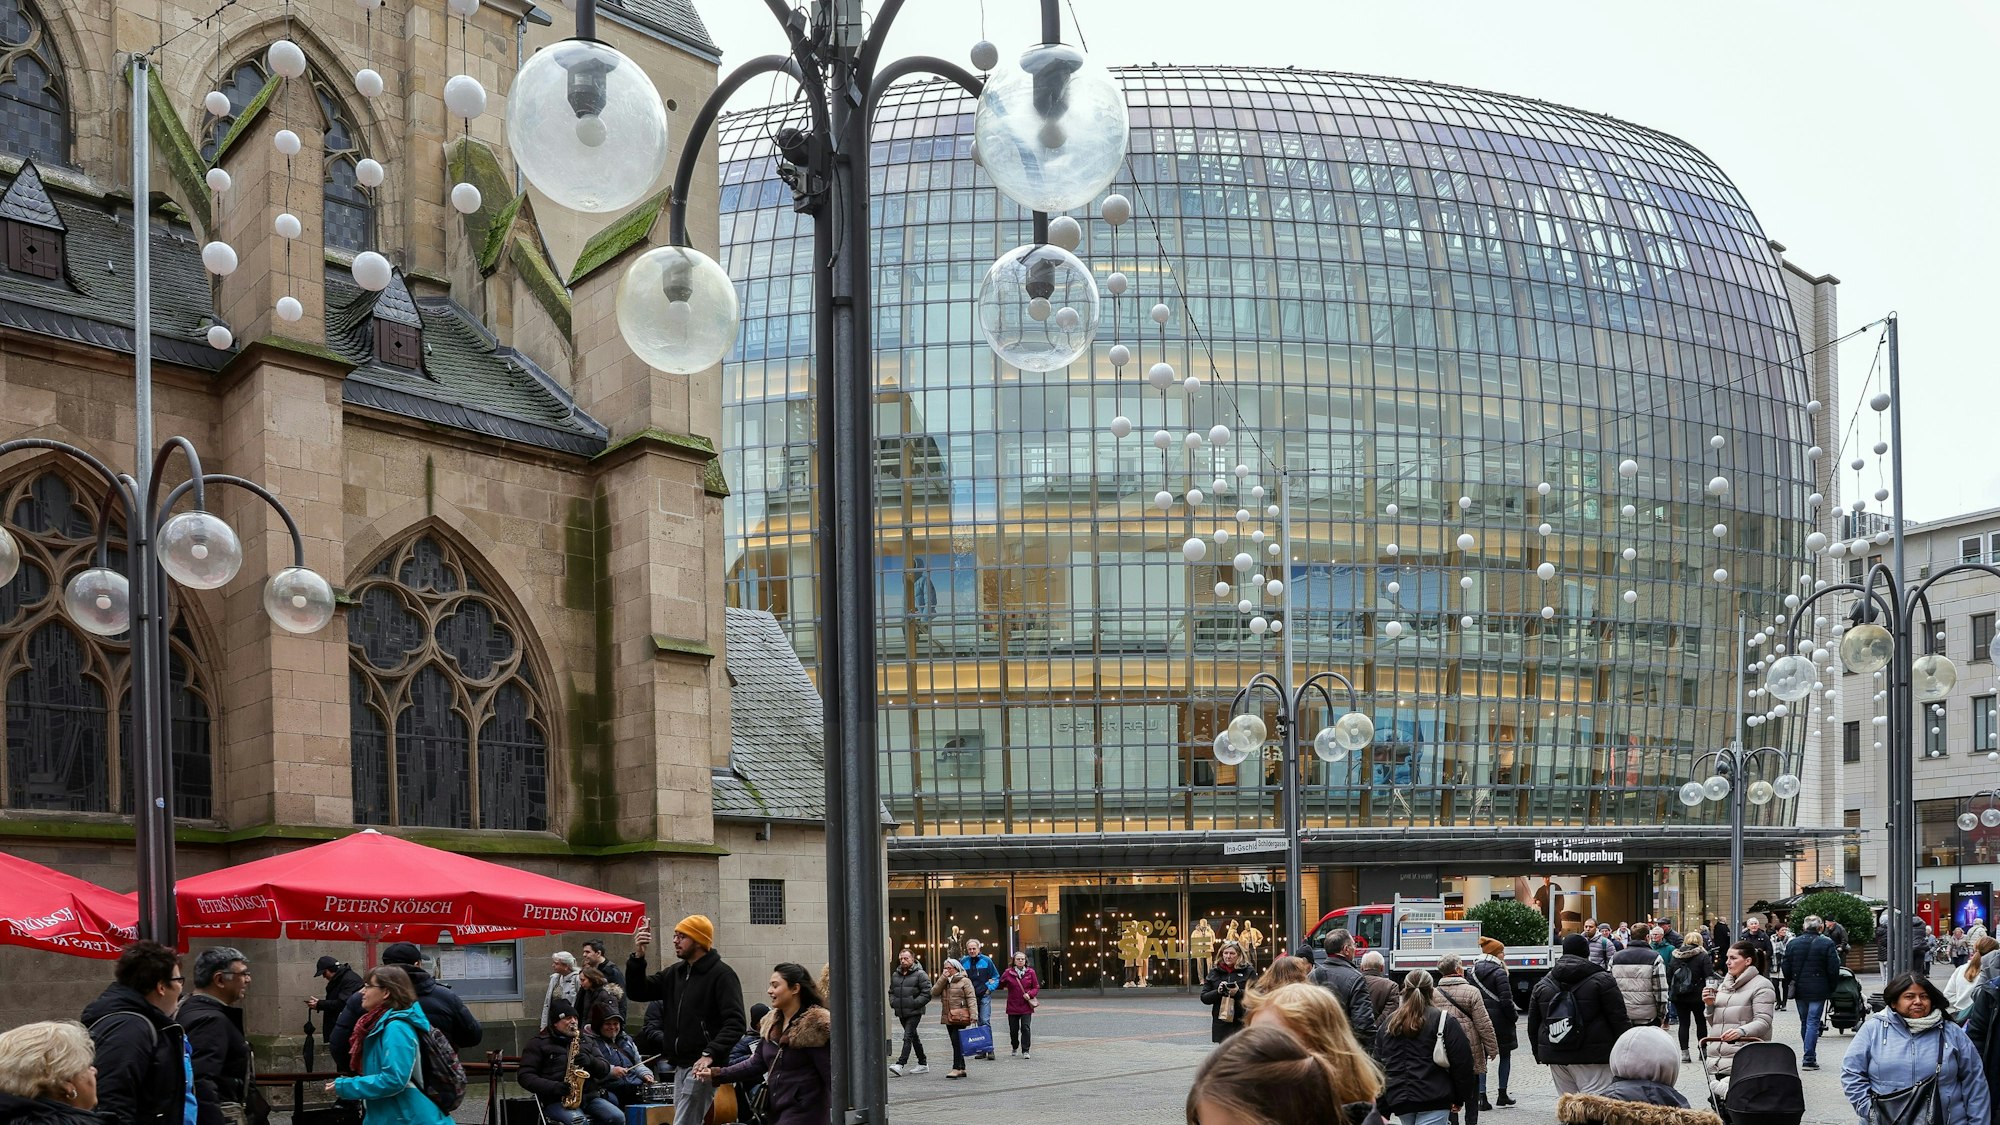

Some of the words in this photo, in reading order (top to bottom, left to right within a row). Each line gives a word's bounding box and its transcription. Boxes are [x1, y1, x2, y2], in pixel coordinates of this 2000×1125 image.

[1258, 839, 1286, 849] Schildergasse
[197, 896, 231, 914] PETERS
[230, 894, 267, 911] KÖLSCH
[324, 895, 390, 913] PETERS
[391, 897, 453, 914] KÖLSCH
[523, 903, 578, 921] PETERS
[580, 907, 632, 924] KÖLSCH
[1120, 920, 1177, 936] 50%
[1118, 937, 1211, 960] SALE
[1549, 1018, 1570, 1036] NIKE
